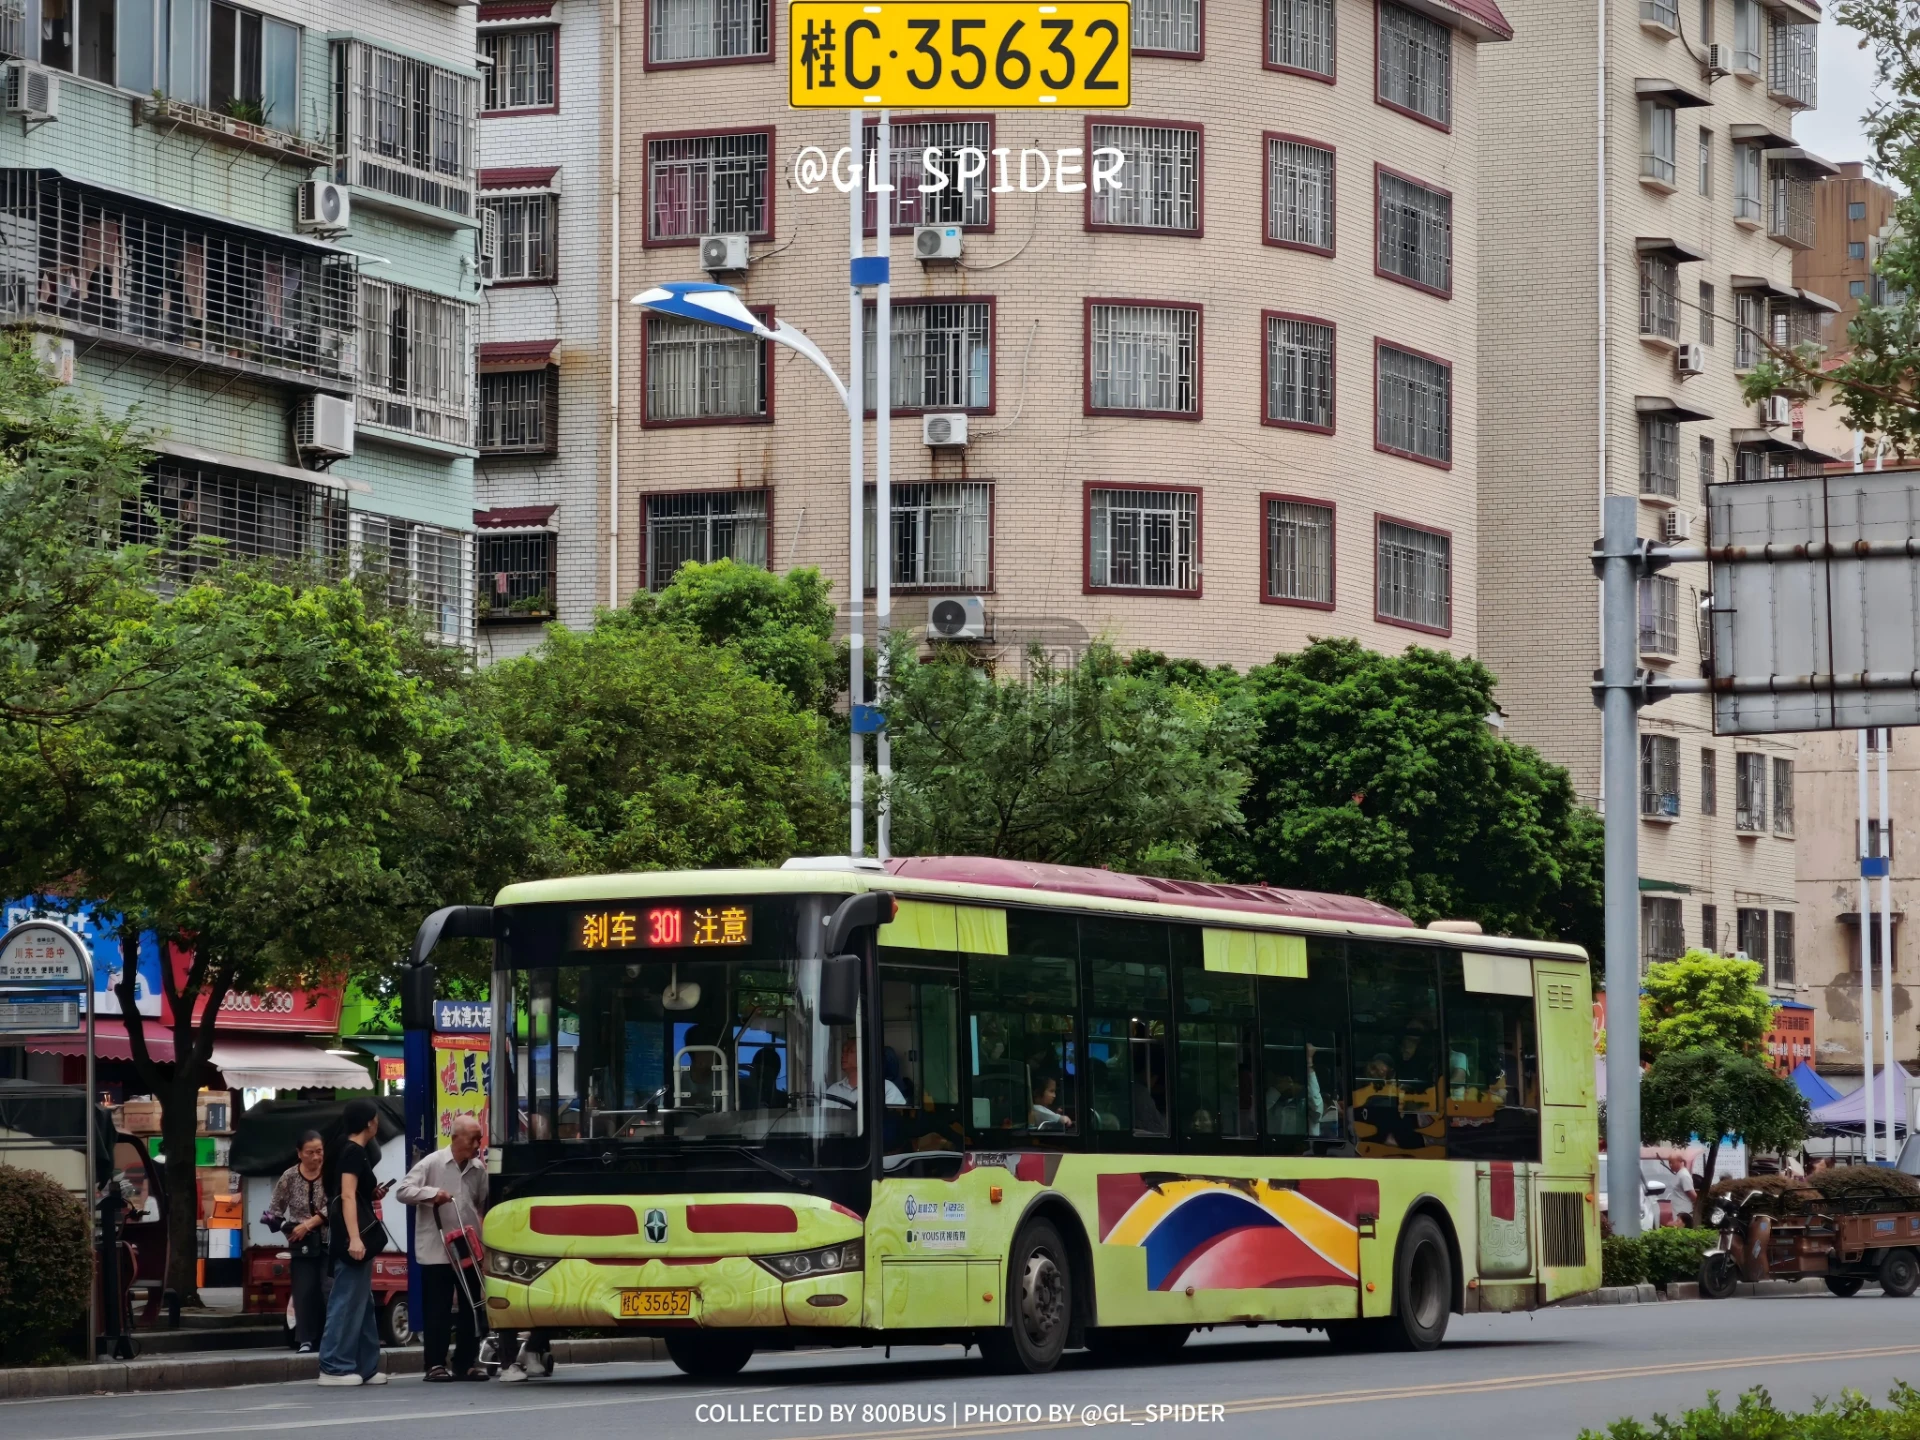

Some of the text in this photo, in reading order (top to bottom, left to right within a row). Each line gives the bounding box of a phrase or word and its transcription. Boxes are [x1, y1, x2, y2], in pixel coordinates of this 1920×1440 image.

[583, 907, 747, 948] 刹车 301 注意
[15, 947, 65, 958] 川东二路中
